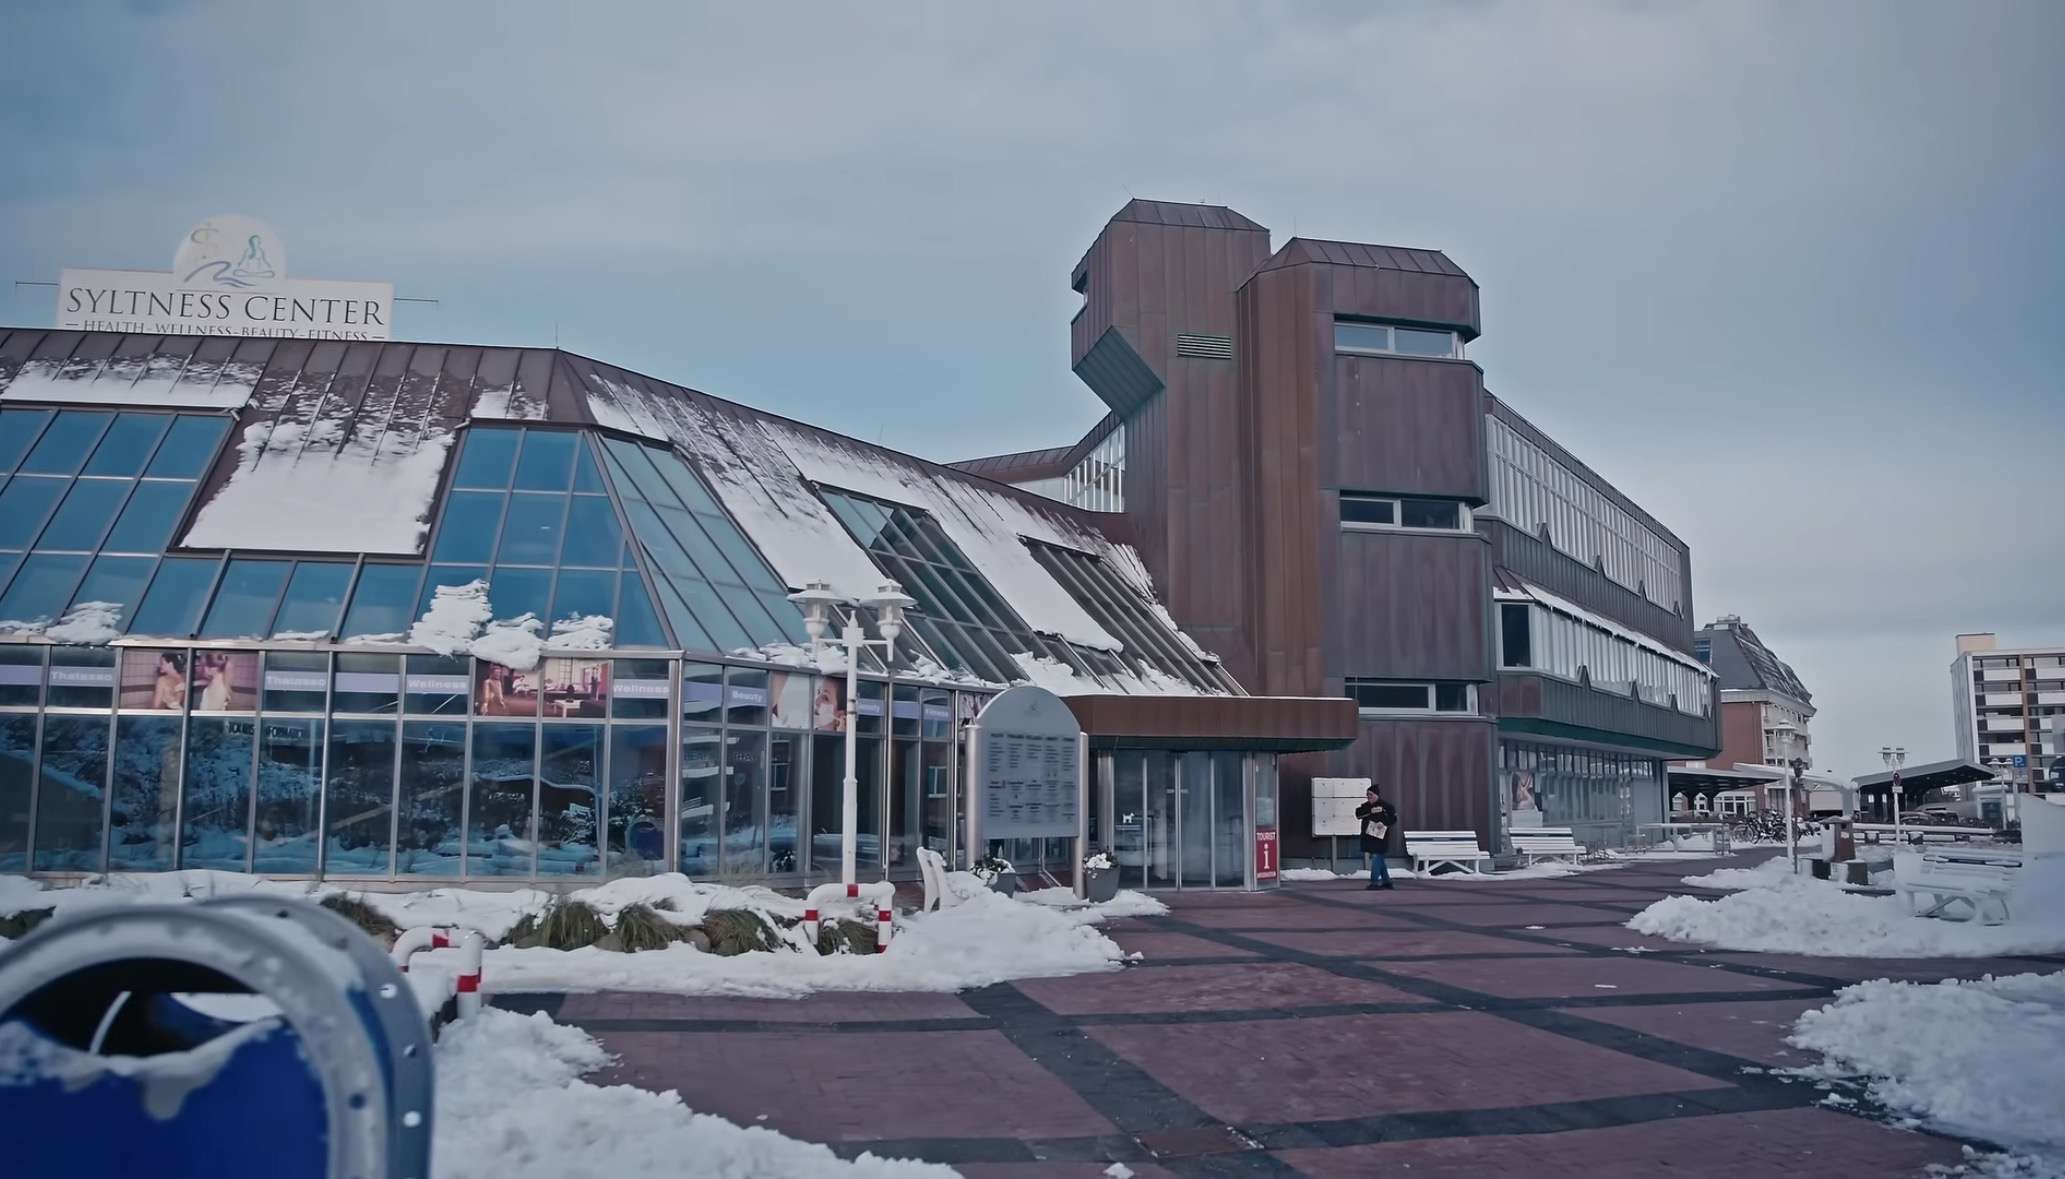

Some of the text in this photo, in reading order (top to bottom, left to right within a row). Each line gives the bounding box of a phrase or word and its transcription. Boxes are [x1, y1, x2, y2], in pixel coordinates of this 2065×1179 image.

[66, 287, 385, 325] SYLTNESS CENTER
[407, 679, 467, 689] Wellness
[613, 684, 670, 695] Wellness
[732, 690, 763, 703] Beauty
[2014, 756, 2024, 767] P
[1256, 831, 1276, 841] TOURIST
